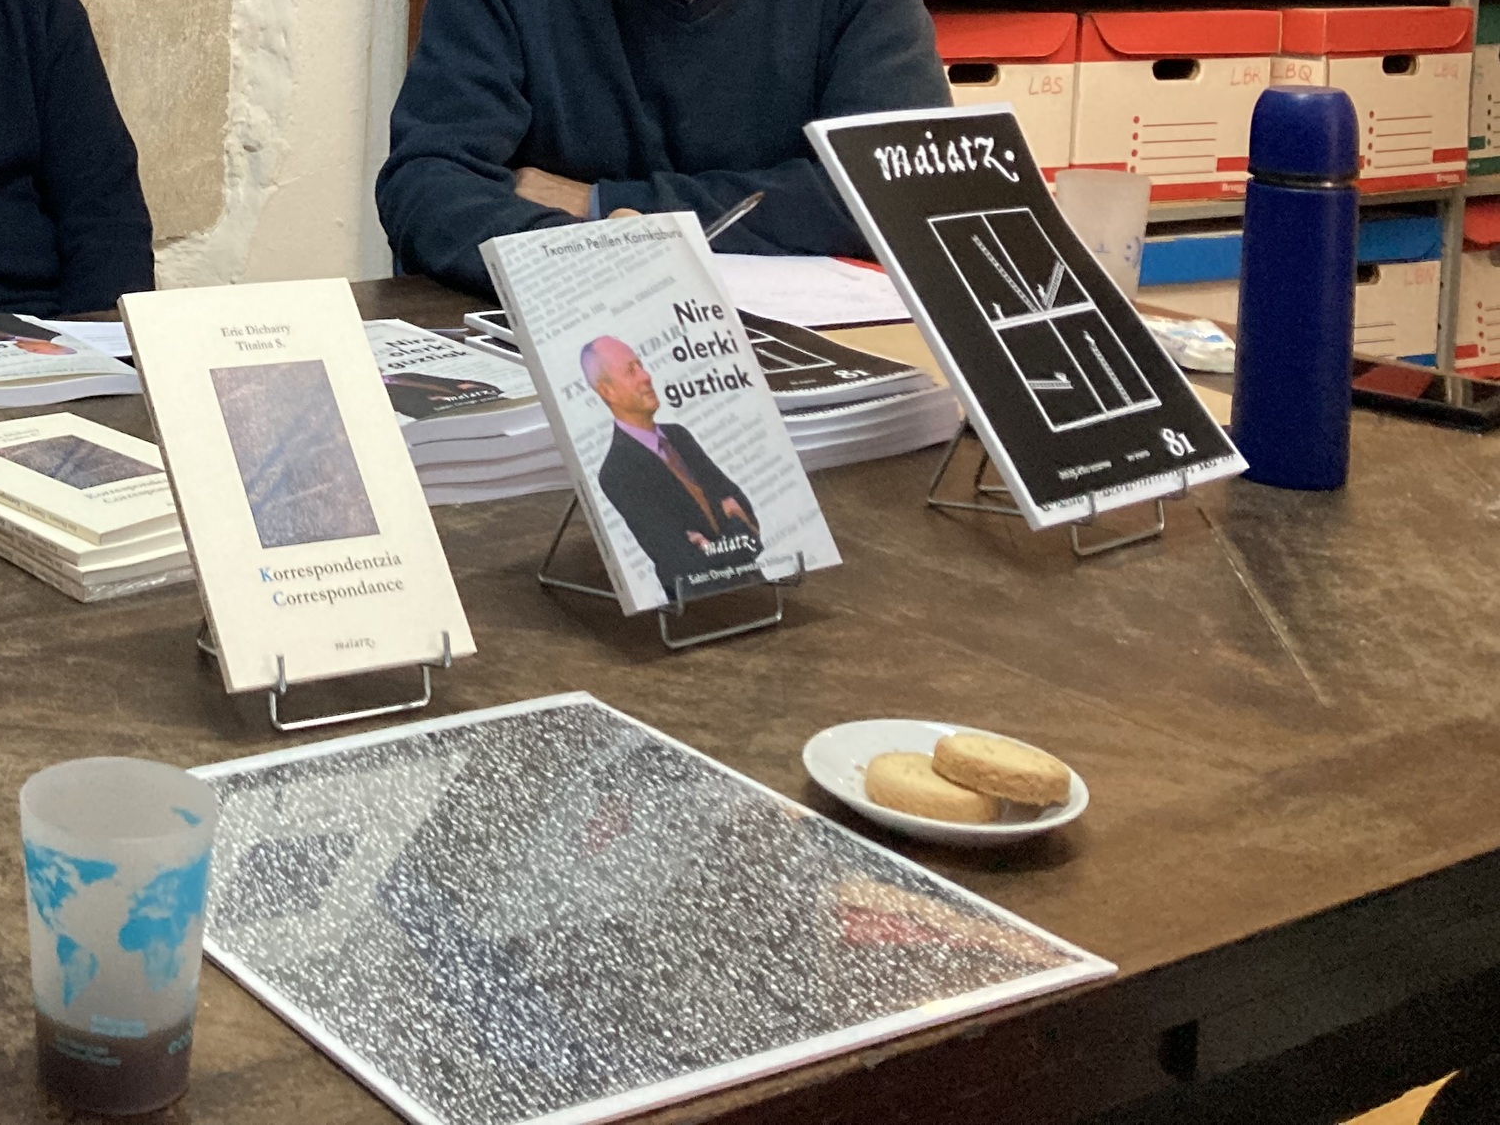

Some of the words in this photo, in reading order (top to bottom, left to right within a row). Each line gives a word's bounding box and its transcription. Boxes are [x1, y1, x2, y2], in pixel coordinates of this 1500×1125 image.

[1270, 62, 1313, 84] LBQ
[1029, 76, 1063, 96] LBS
[541, 241, 585, 259] Txomin
[672, 298, 724, 326] Nire
[220, 326, 244, 337] Eric
[385, 338, 437, 348] Nire
[389, 344, 454, 357] olerki
[672, 329, 739, 363] olerki
[388, 351, 466, 369] guztiak
[834, 370, 870, 379] 81
[664, 363, 754, 408] guztiak
[1161, 428, 1197, 457] 81
[259, 551, 403, 583] Korrespondentzia
[272, 579, 404, 606] Correspondance
